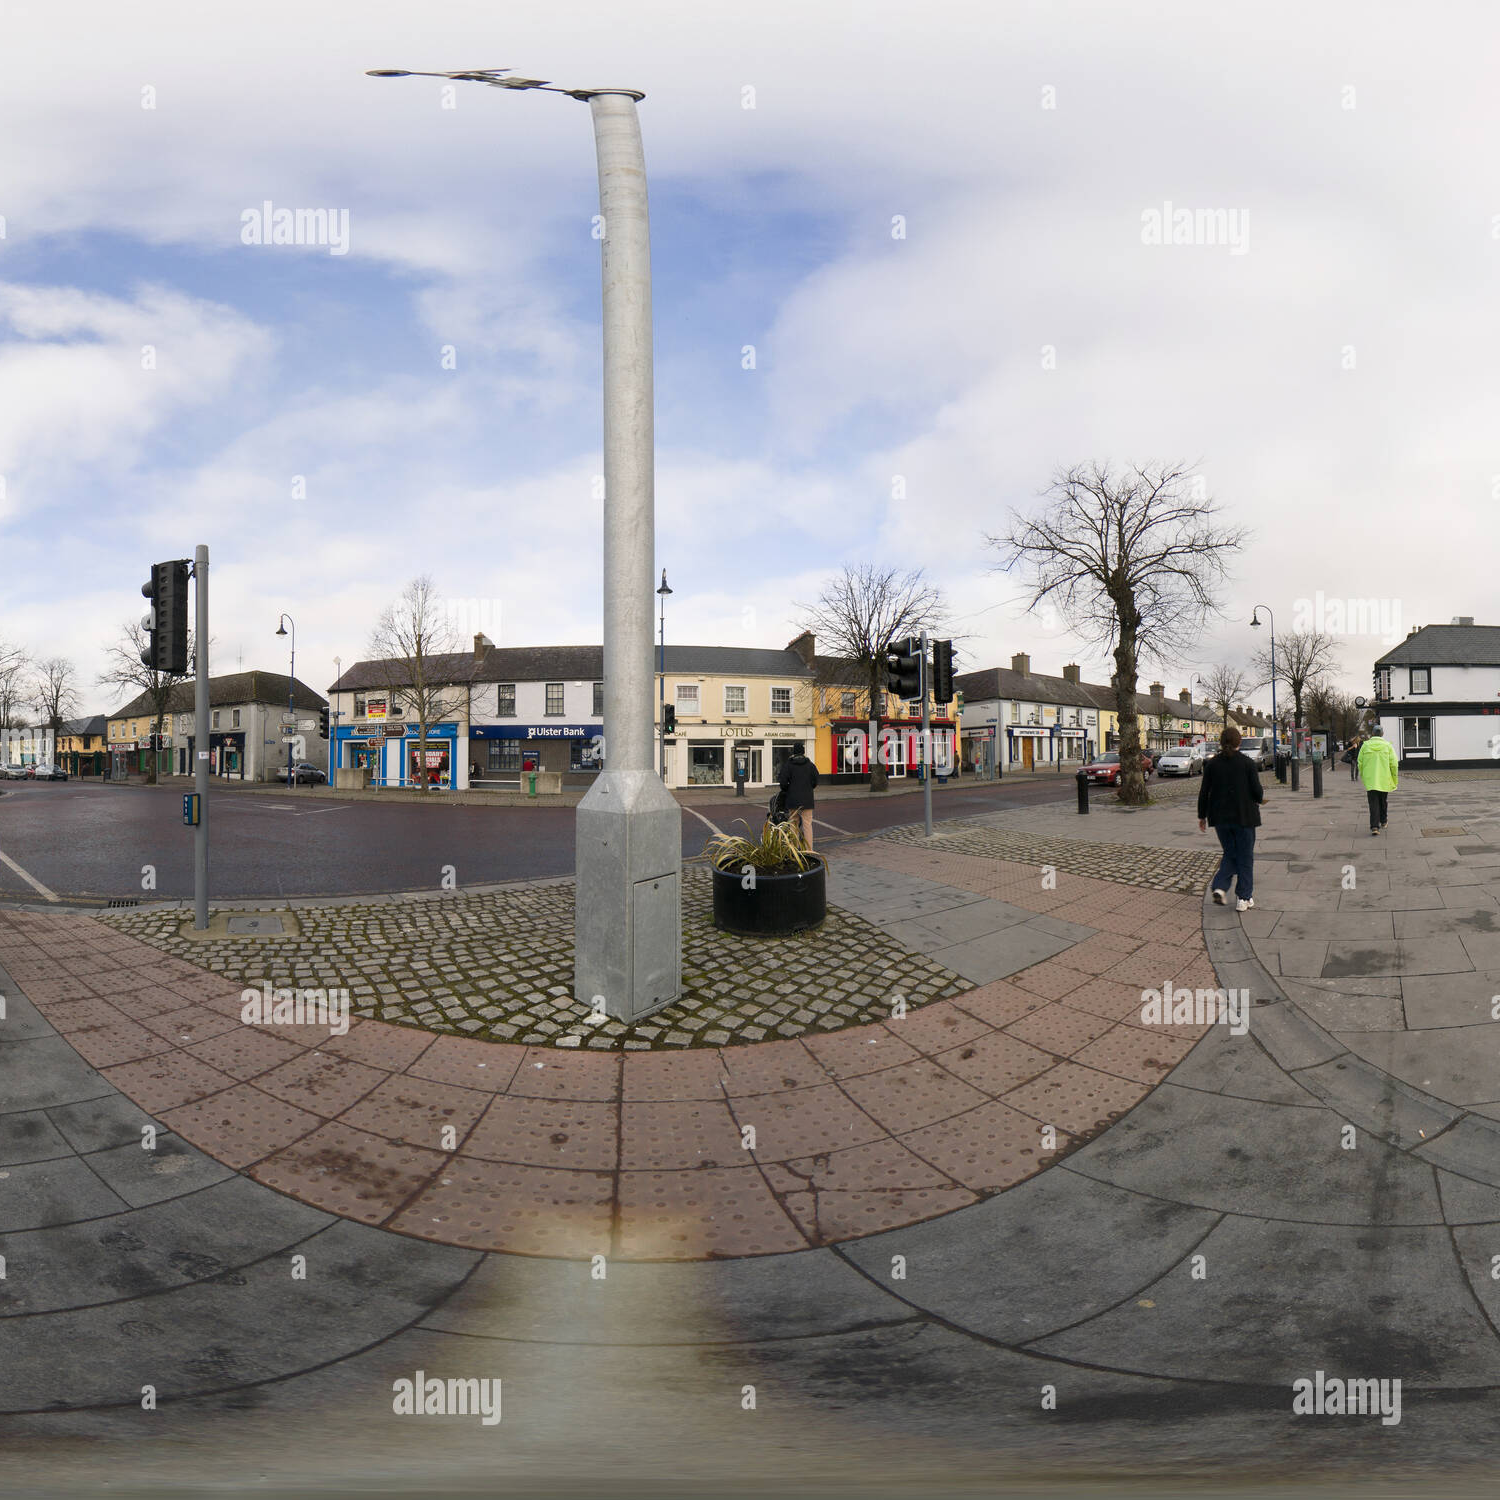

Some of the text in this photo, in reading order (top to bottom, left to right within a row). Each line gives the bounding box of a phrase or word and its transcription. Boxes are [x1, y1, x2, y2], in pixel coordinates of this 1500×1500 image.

[536, 727, 585, 736] Ulster Bank
[720, 727, 754, 737] LOTUS
